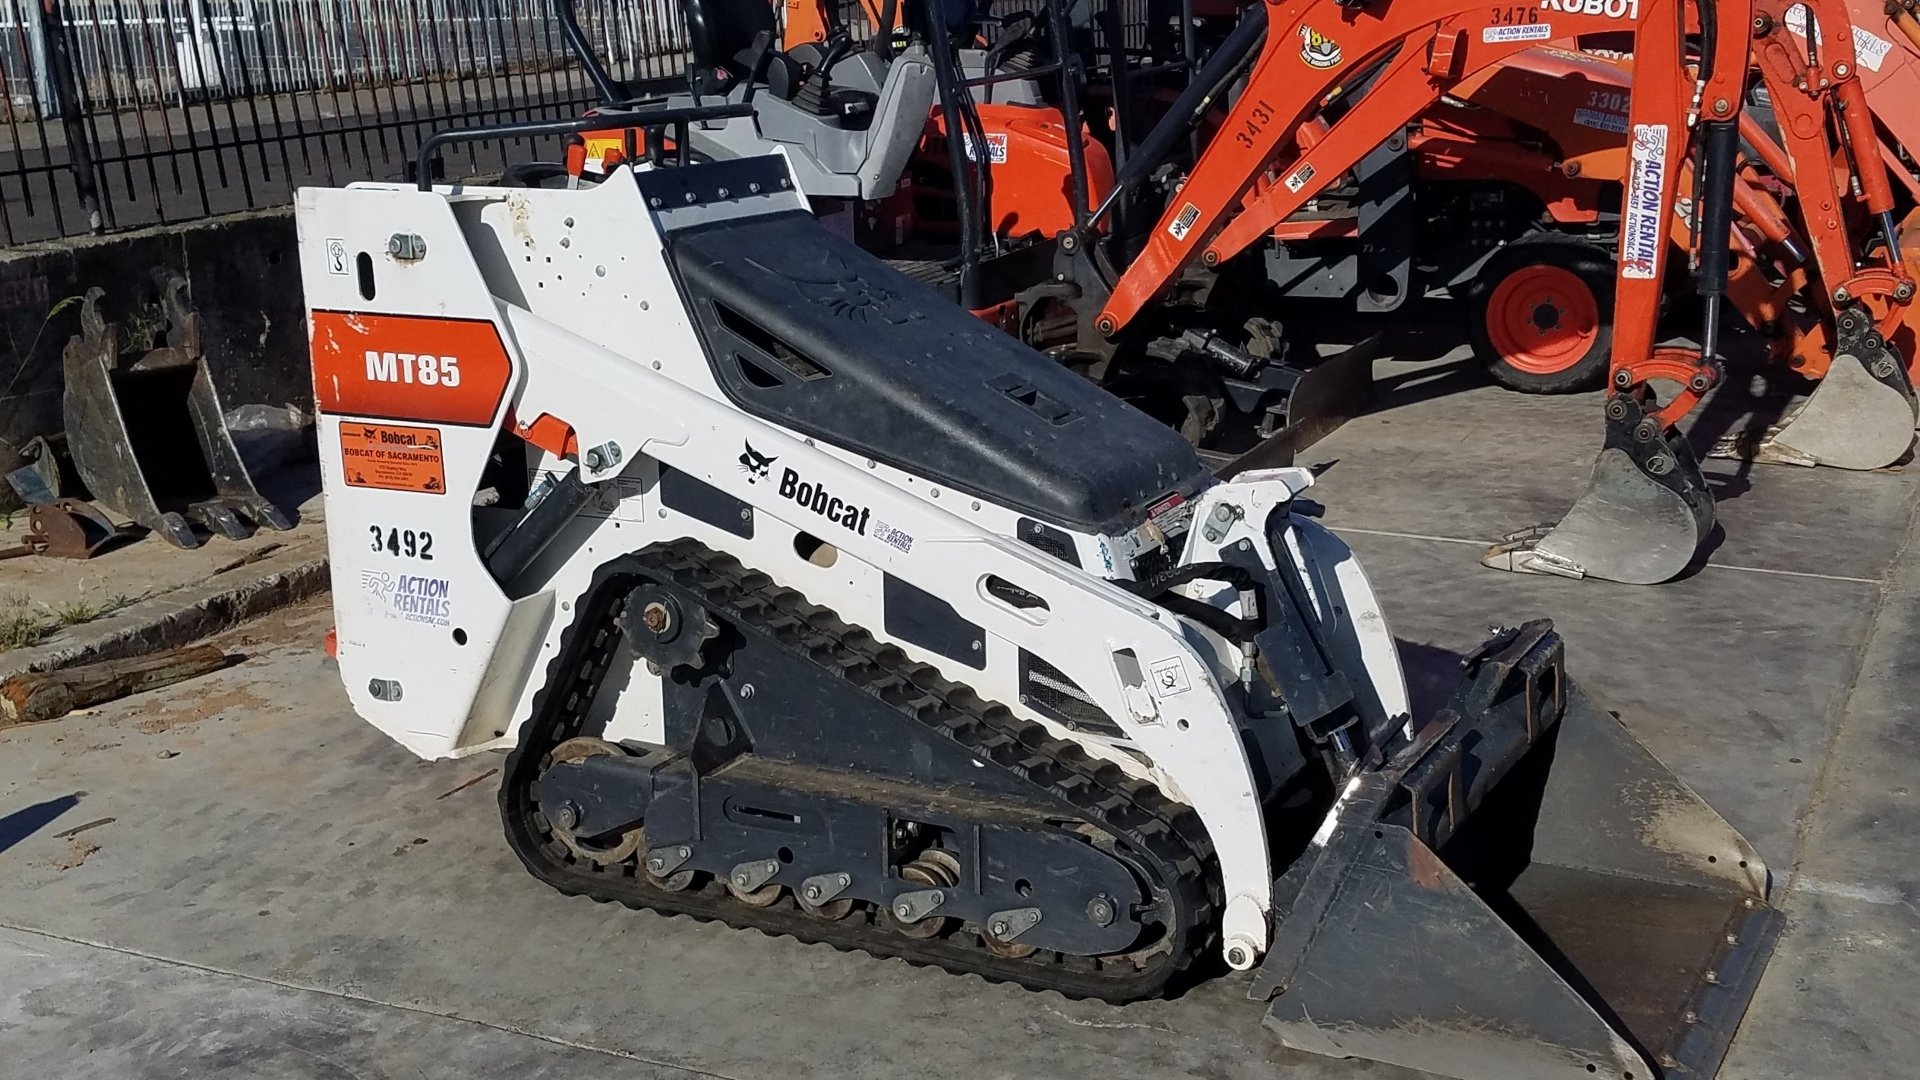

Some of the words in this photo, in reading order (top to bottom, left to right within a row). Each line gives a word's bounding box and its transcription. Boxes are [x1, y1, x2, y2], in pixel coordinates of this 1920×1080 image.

[1490, 7, 1538, 25] 3476
[1498, 26, 1520, 36] ACTION
[1522, 25, 1549, 35] RENTALS
[1587, 91, 1630, 113] 3302
[1236, 100, 1275, 148] 3431
[1641, 158, 1662, 213] ACTION
[365, 350, 460, 387] MT85
[381, 430, 417, 446] Bobcat
[344, 447, 374, 458] BOBCAT
[375, 450, 386, 459] OF
[387, 451, 440, 463] SACRAMENTO
[779, 466, 870, 537] Bobcat
[369, 525, 434, 560] 3492
[886, 534, 912, 551] RENTALS
[890, 528, 914, 543] ACTION
[397, 575, 450, 598] ACTION
[393, 593, 451, 618] RENTALS
